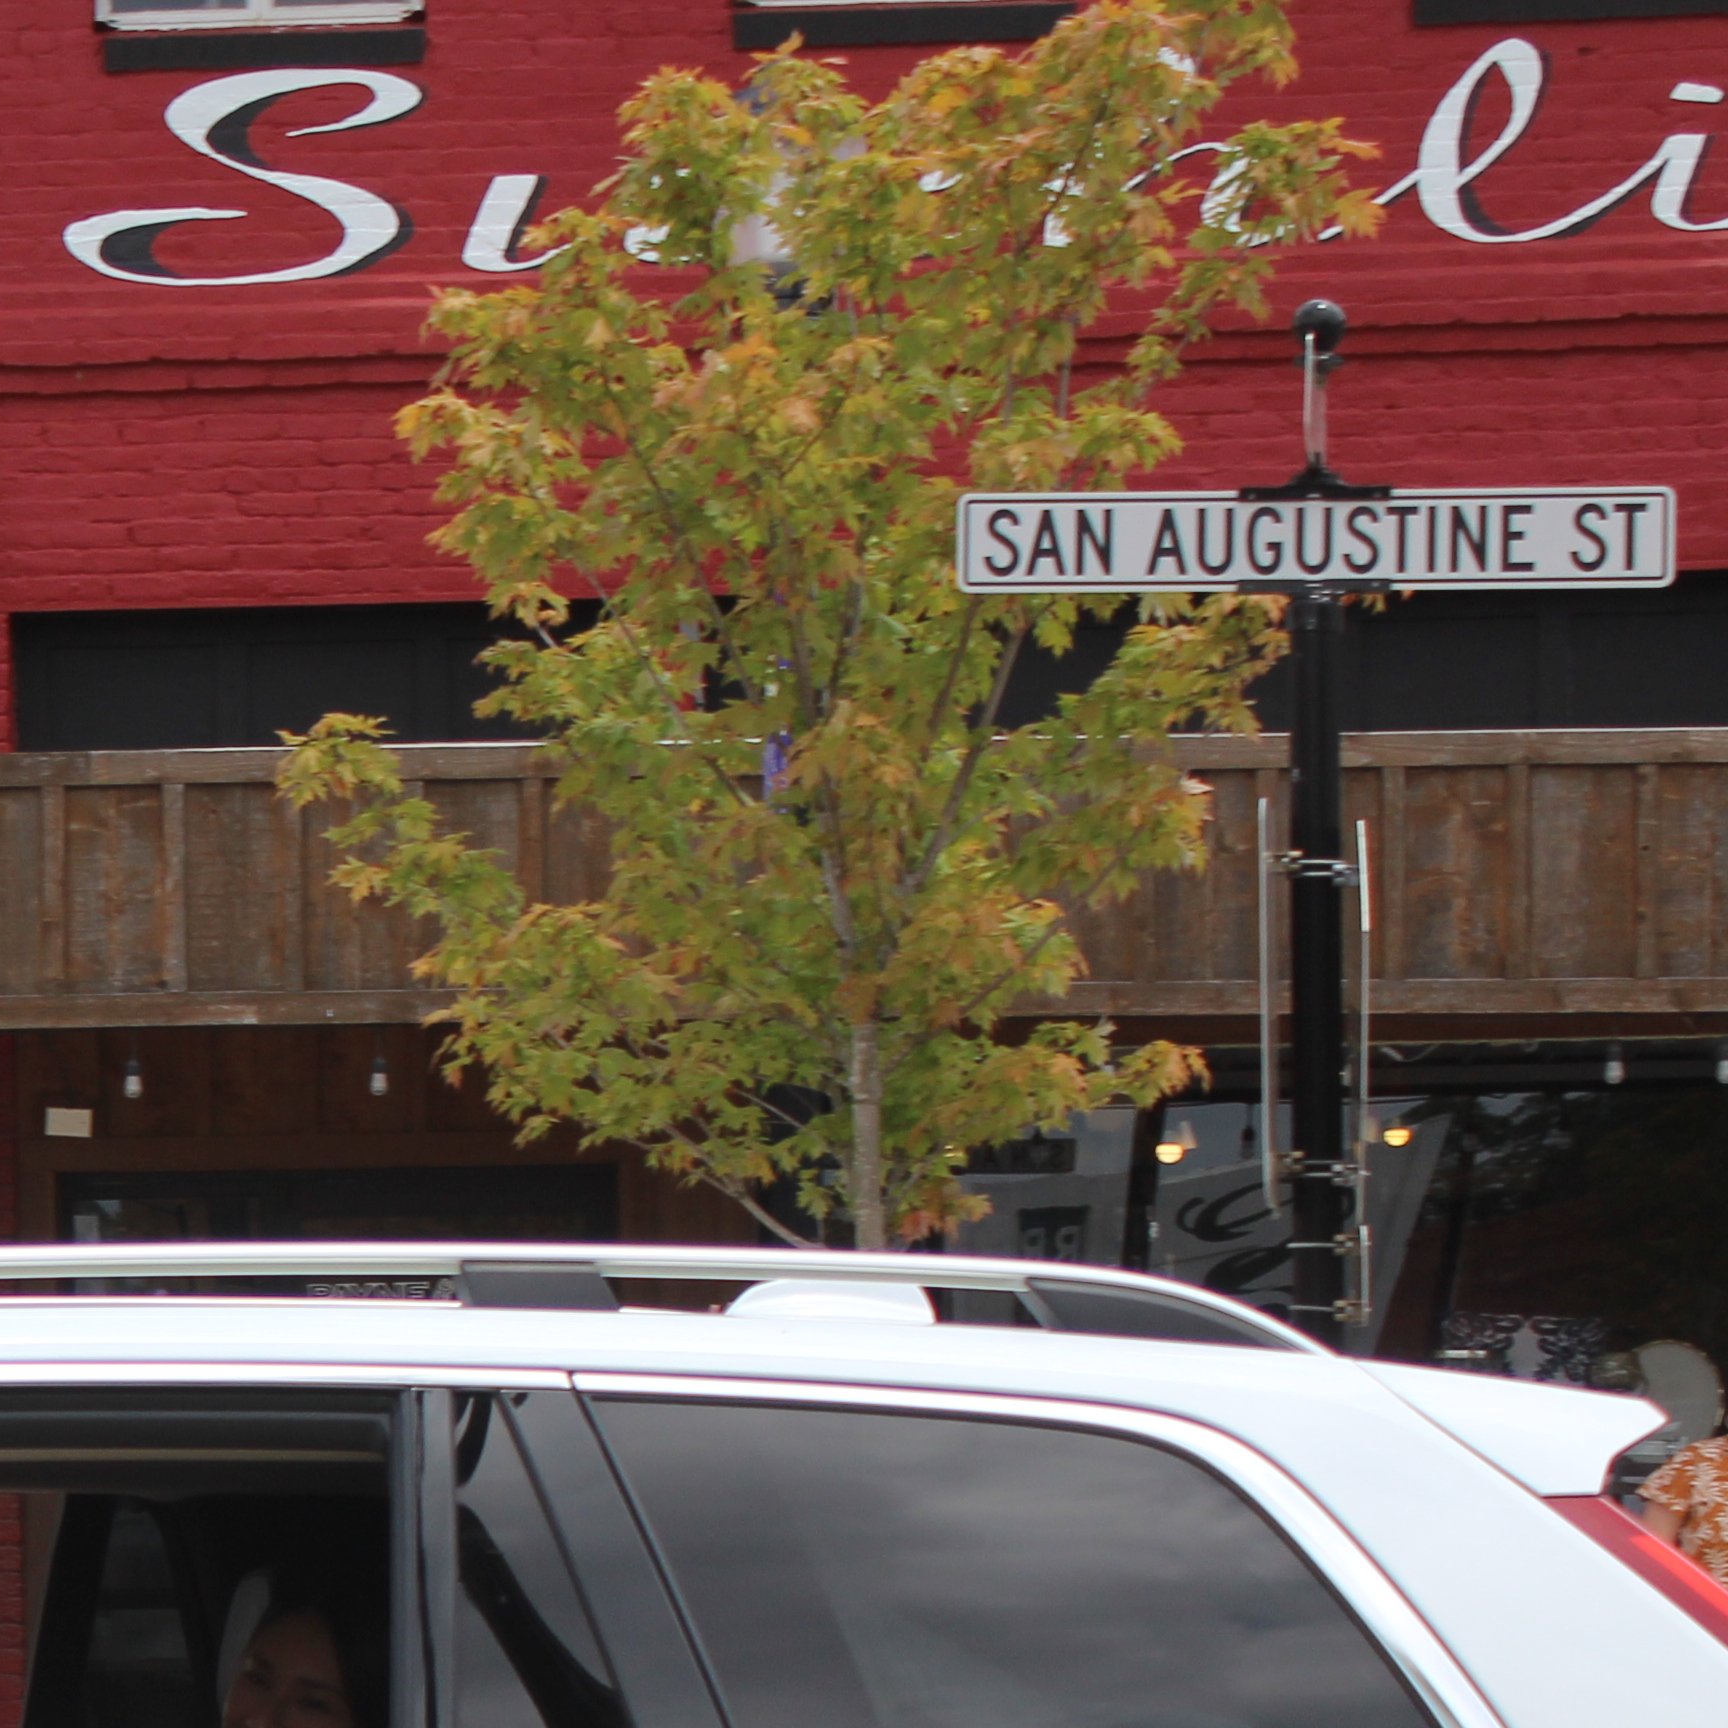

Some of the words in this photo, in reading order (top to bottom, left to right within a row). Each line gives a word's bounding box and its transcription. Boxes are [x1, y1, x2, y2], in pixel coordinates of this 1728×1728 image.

[983, 508, 1113, 578] SAN
[1148, 504, 1536, 577] AUGUSTINE
[1570, 502, 1647, 572] ST
